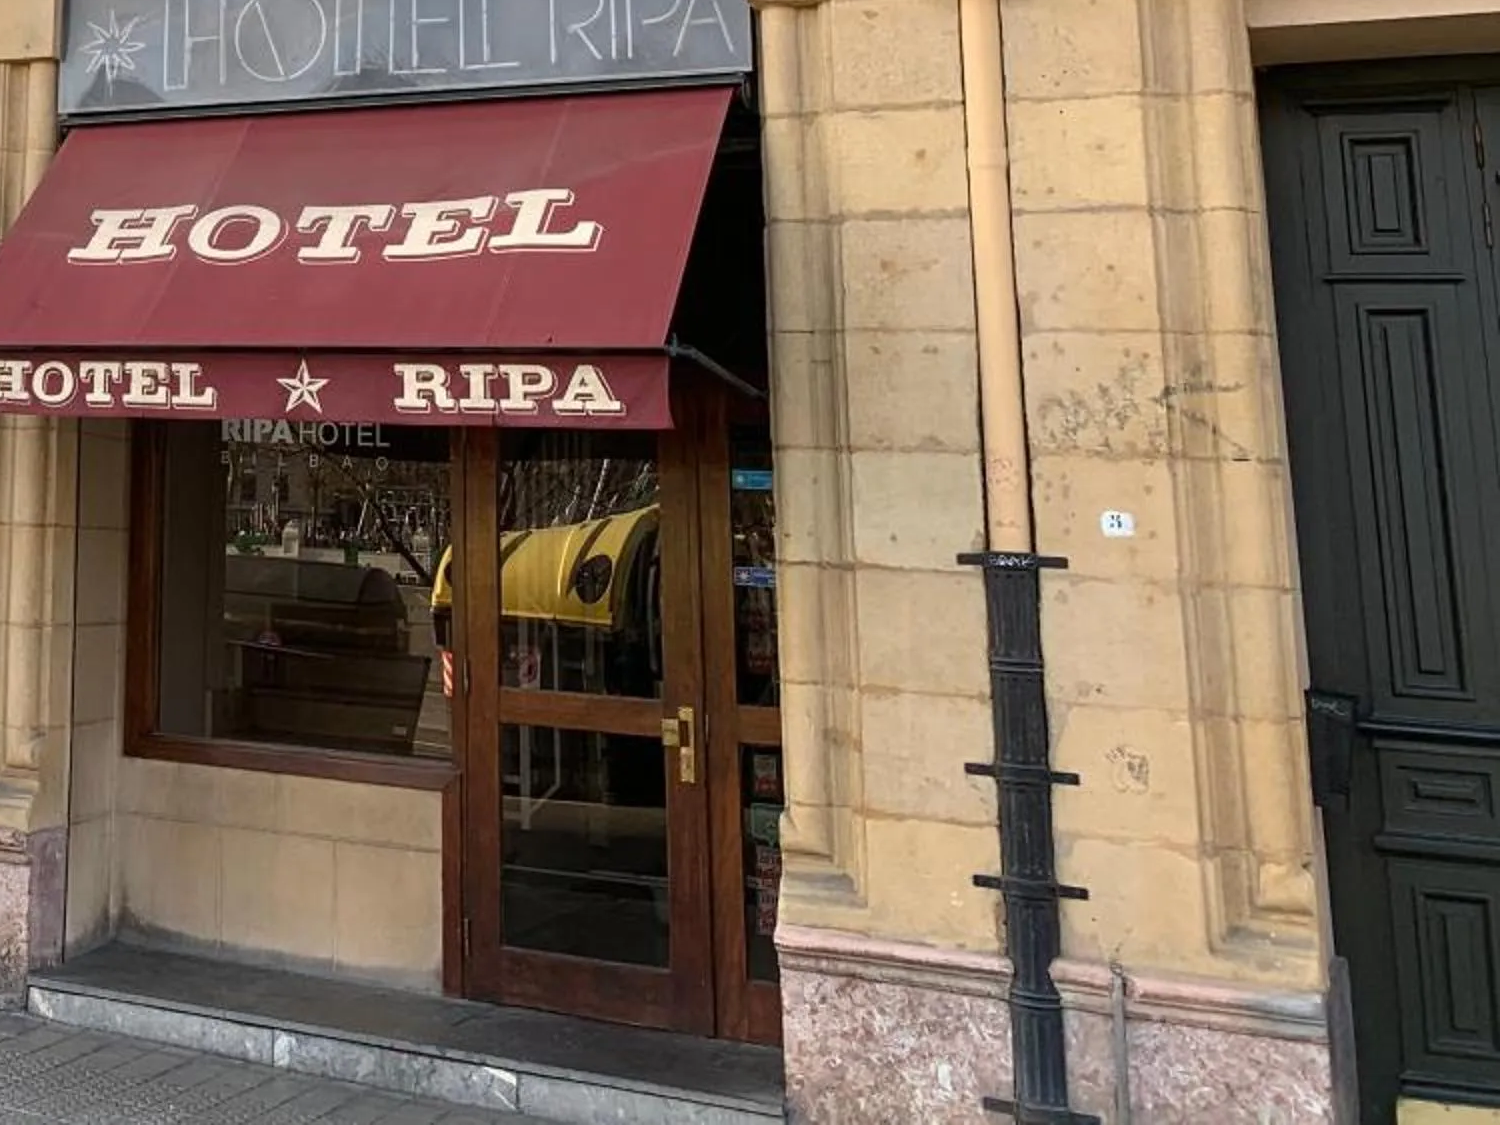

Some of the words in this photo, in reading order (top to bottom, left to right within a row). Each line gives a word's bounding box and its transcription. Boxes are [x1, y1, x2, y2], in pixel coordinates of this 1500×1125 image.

[67, 187, 604, 266] HOTEL
[393, 362, 626, 418] RIPA
[220, 418, 295, 444] RIPA
[300, 421, 391, 448] HOTEL
